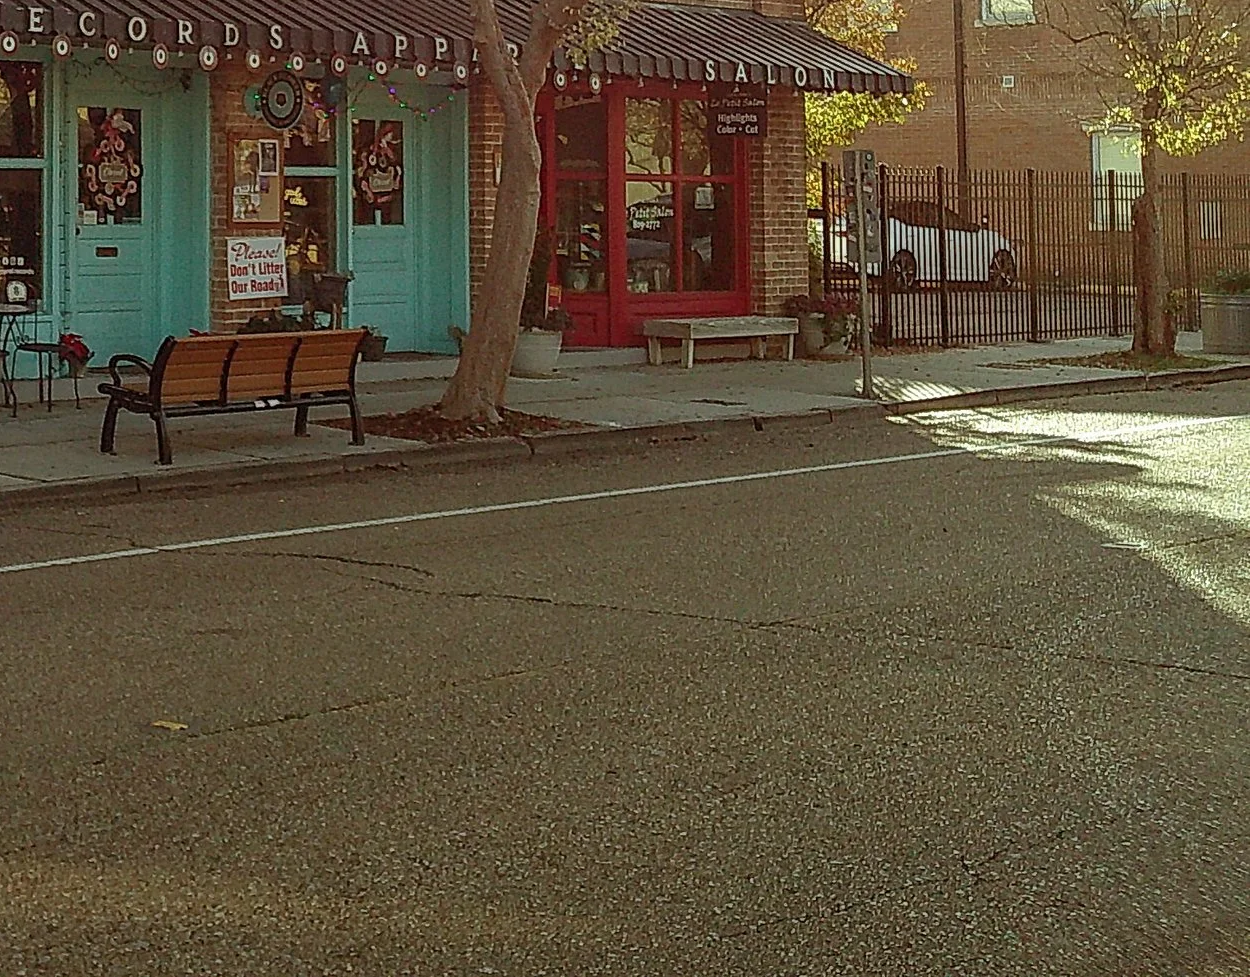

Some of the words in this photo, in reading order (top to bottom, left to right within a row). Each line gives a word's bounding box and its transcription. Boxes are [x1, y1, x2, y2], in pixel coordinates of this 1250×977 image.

[705, 59, 836, 89] SALON
[717, 113, 758, 124] Highlights
[716, 124, 737, 134] Color
[745, 124, 759, 134] Cut
[231, 242, 282, 262] Please!
[230, 264, 256, 277] Don't
[259, 262, 284, 275] Litter
[231, 281, 248, 294] Our
